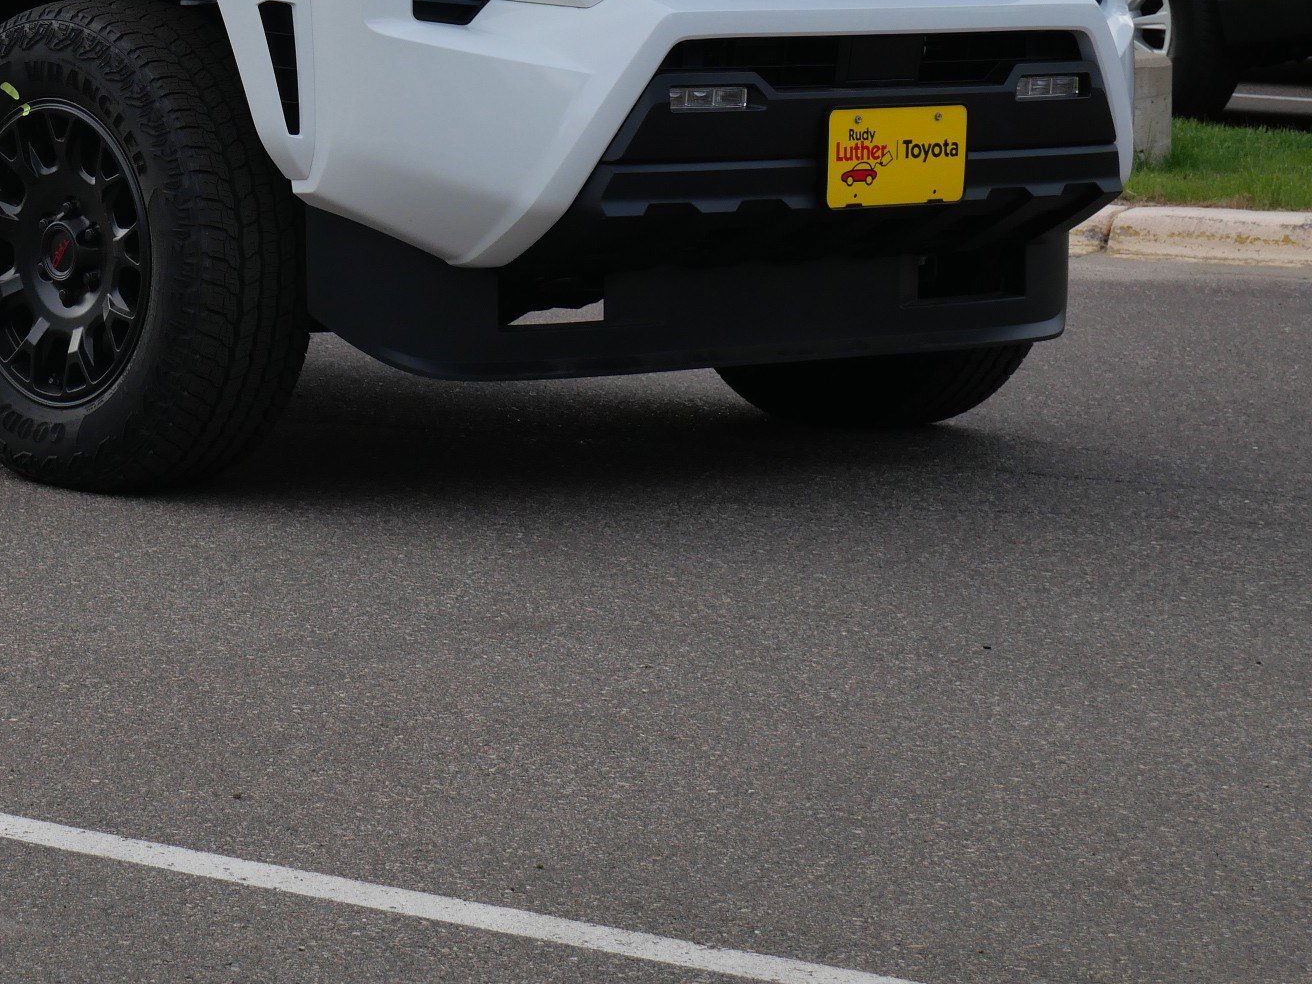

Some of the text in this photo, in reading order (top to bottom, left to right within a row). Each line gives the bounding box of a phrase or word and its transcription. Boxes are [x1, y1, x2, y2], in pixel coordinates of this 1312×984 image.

[848, 128, 876, 143] Rudy
[835, 138, 959, 163] Luther Toyota
